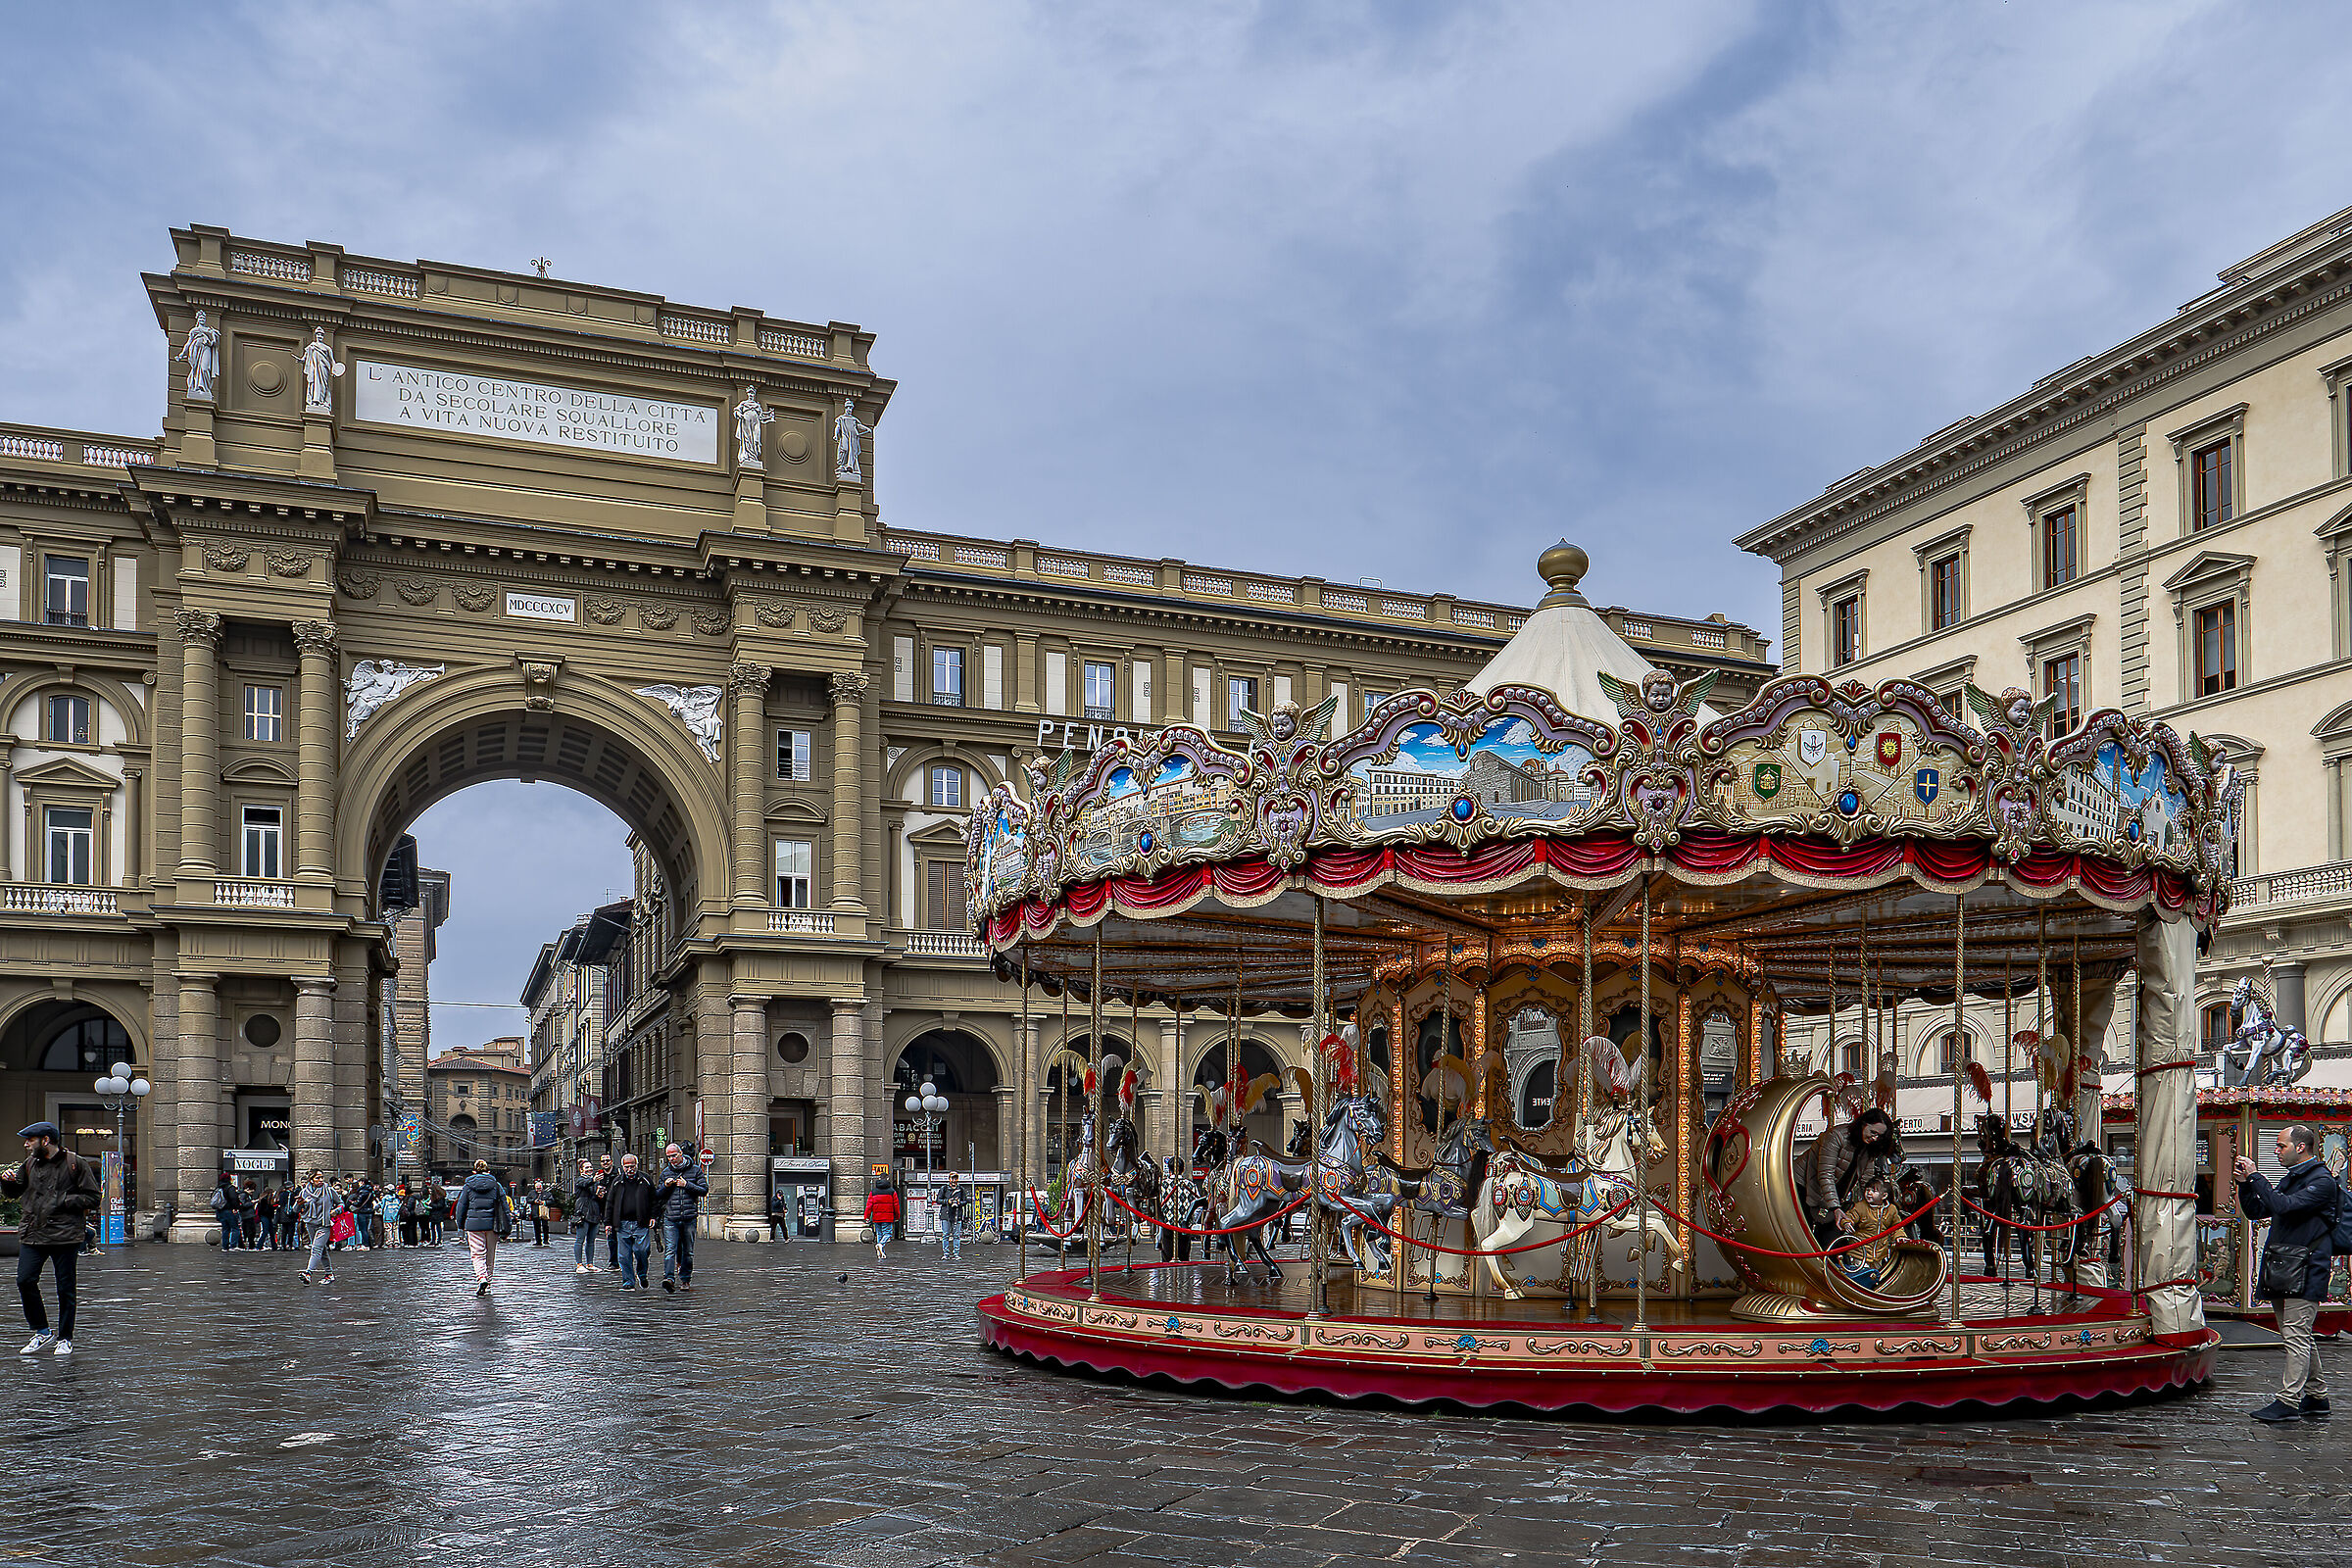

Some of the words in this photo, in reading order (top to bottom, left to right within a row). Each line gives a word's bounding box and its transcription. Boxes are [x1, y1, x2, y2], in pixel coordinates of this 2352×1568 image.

[392, 370, 468, 392] ANTICO
[477, 381, 562, 404] CENTRO
[570, 393, 638, 415] DELLA
[399, 388, 426, 404] DA
[436, 393, 548, 419] SECOLARE
[556, 409, 678, 436] SQUALLORE
[399, 406, 412, 419] A
[421, 408, 469, 426] VITA
[479, 416, 549, 436] NUOVA
[559, 425, 679, 452] RESTITUITO
[509, 599, 571, 614] MDCCCXCV
[235, 1159, 274, 1170] VOGUE
